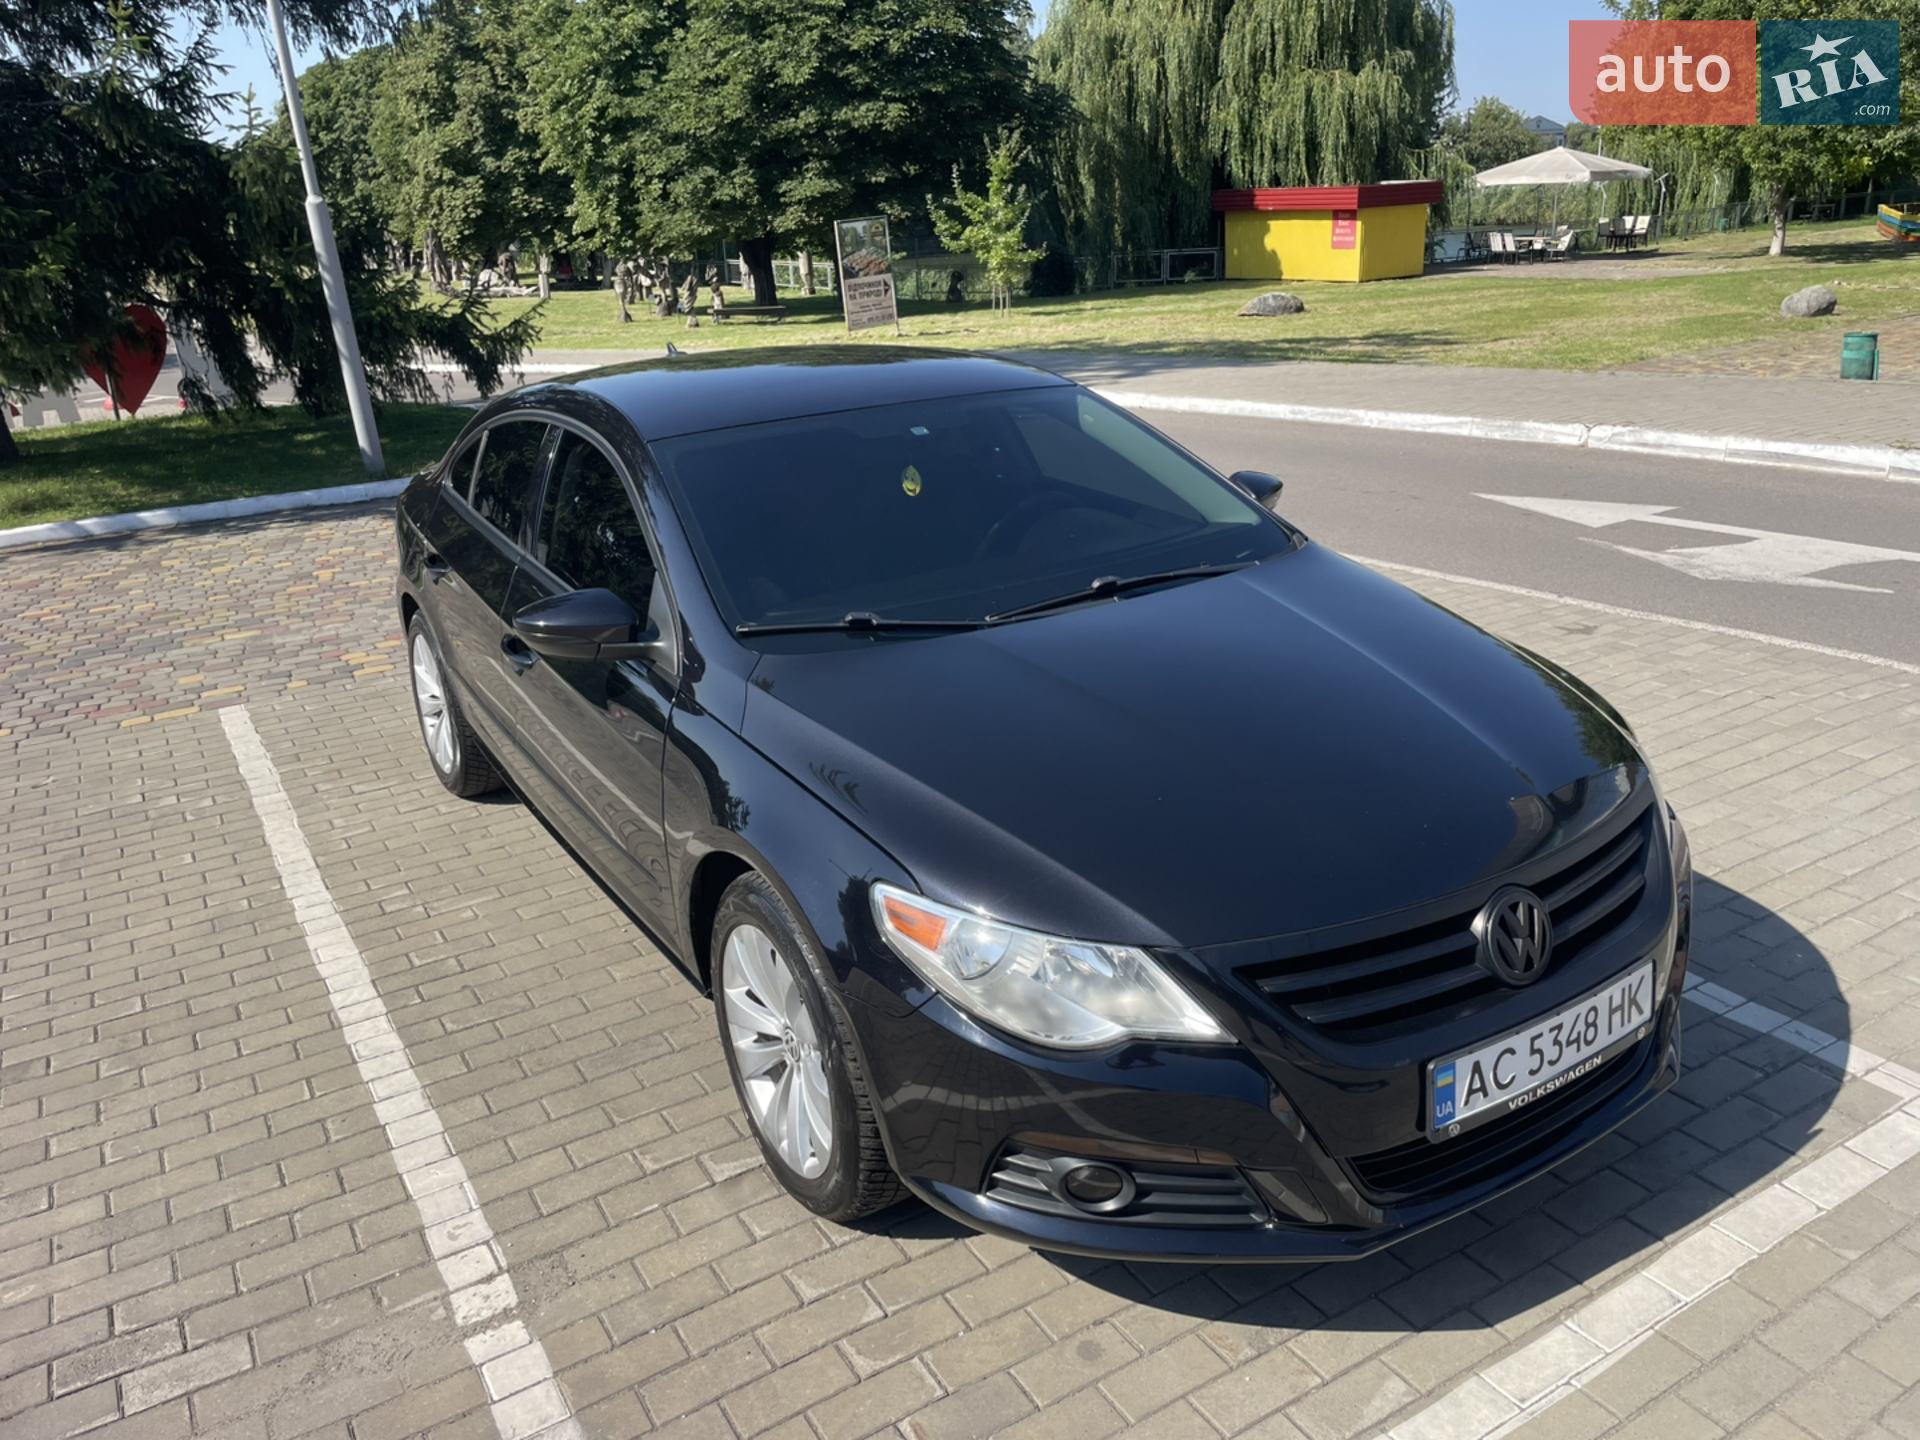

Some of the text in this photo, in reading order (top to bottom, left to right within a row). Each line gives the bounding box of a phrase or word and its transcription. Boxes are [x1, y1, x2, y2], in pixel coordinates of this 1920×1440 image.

[1460, 974, 1645, 1108] AC 5348 HK
[1436, 1101, 1454, 1118] UA
[1508, 1054, 1602, 1111] VOLKSWAGEN
